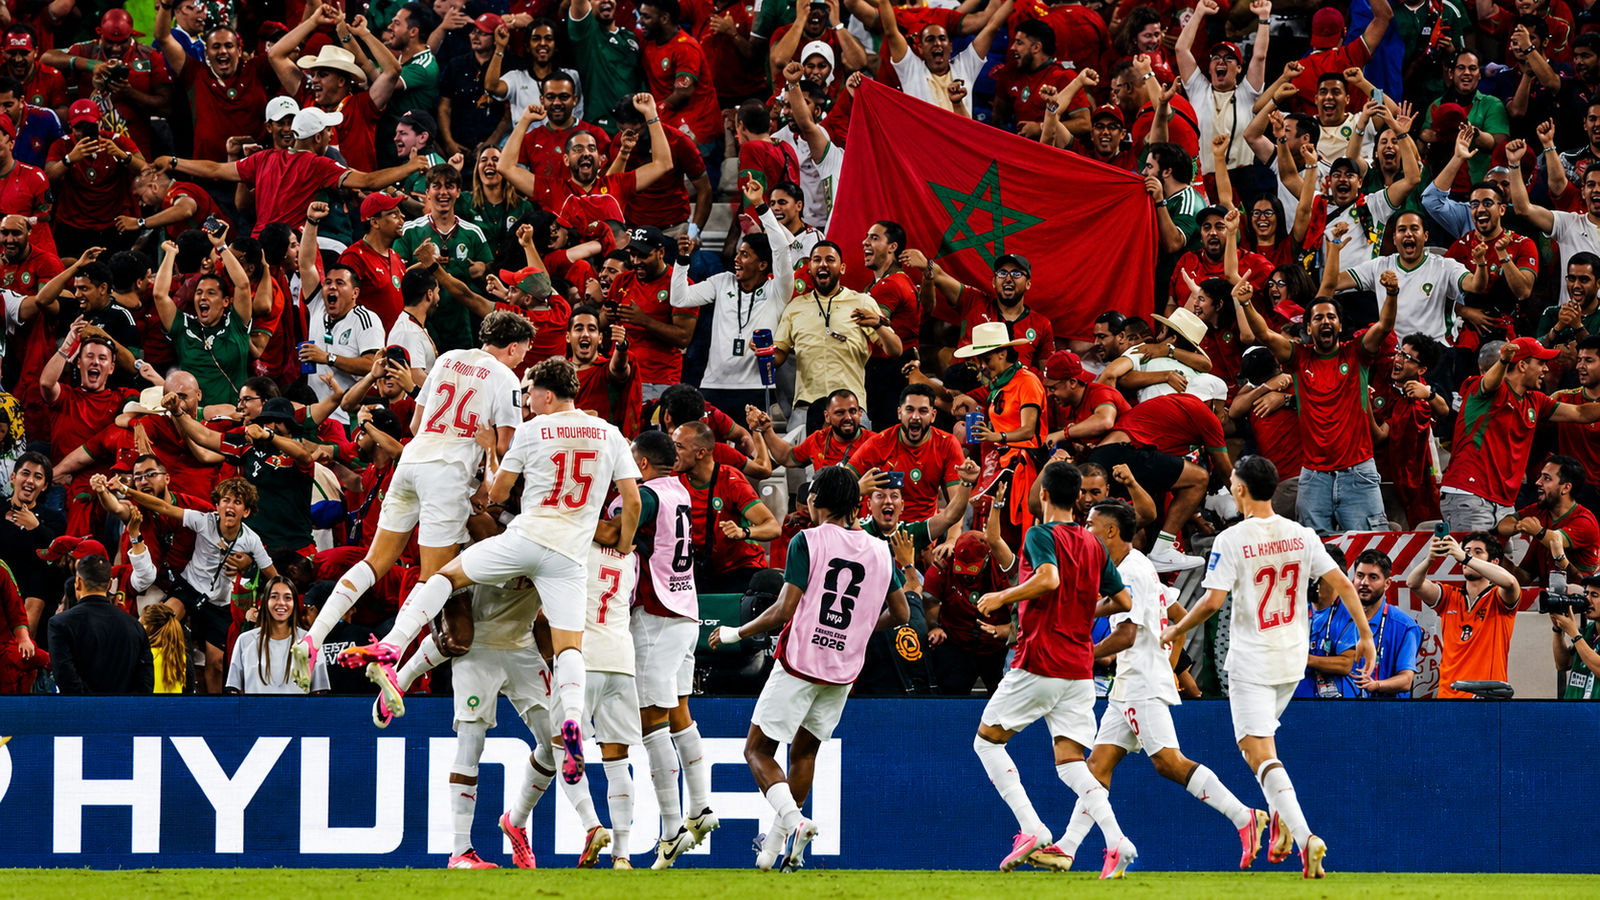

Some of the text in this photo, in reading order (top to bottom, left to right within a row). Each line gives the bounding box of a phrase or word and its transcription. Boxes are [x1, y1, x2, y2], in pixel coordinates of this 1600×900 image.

[425, 380, 480, 438] 24
[541, 427, 555, 440] EL
[541, 450, 599, 510] 15
[1242, 545, 1257, 559] EL
[596, 564, 622, 626] 7
[1254, 560, 1301, 632] 23
[811, 634, 846, 652] 2026
[53, 736, 842, 855] HYUNDAI
